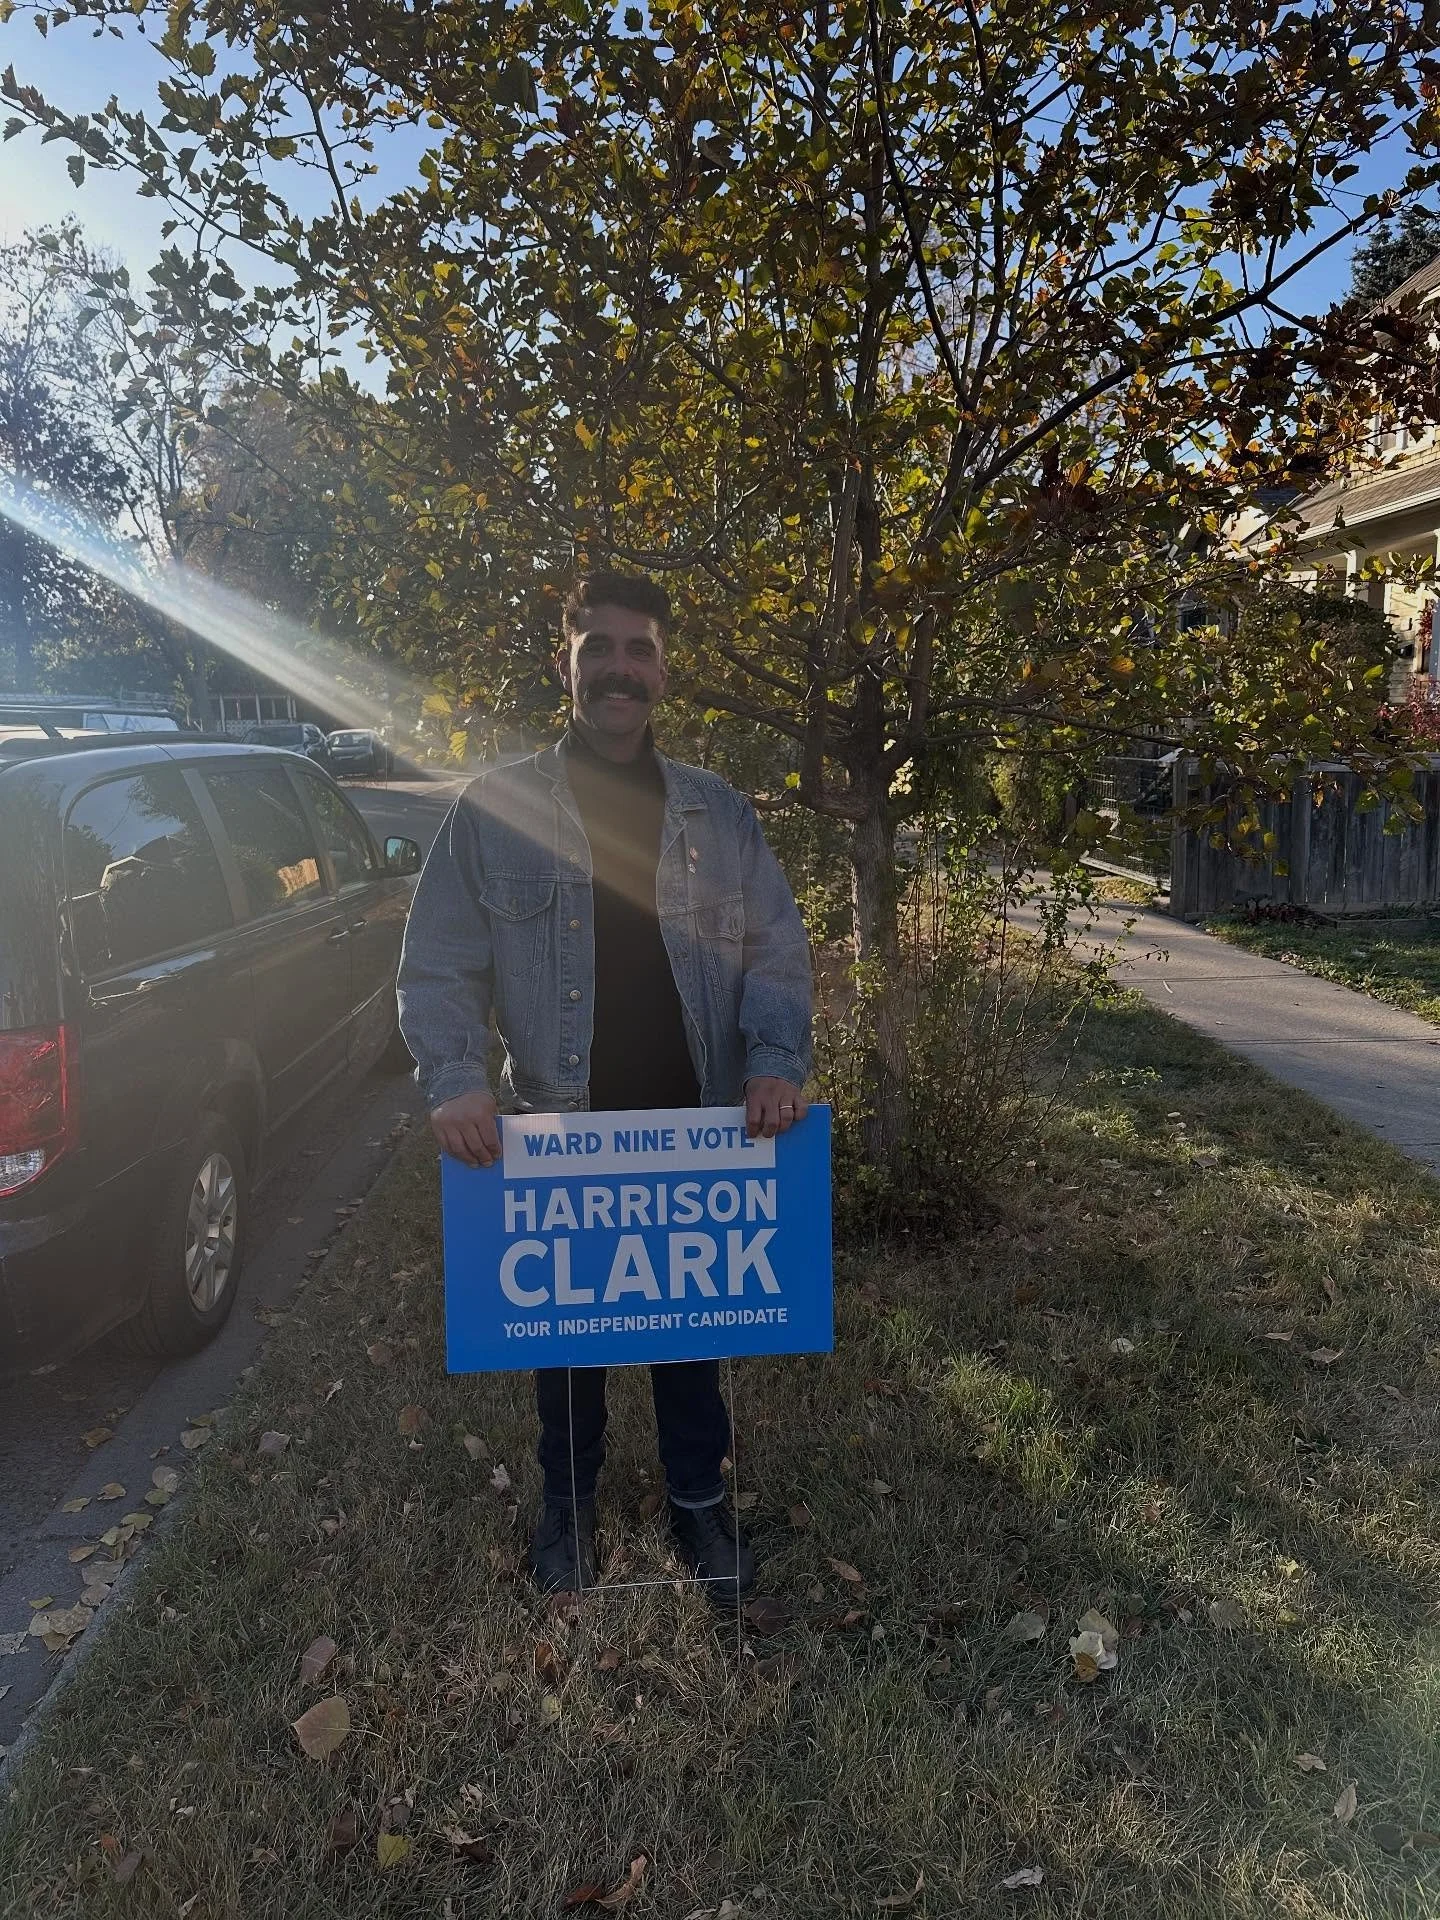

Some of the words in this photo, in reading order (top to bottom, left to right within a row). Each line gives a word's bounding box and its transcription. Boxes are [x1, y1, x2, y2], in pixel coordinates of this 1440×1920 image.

[524, 1132, 602, 1157] WARD
[614, 1128, 676, 1153] NINE
[504, 1179, 777, 1233] HARRISON
[499, 1228, 782, 1308] CLARK
[504, 1320, 551, 1338] YOUR
[558, 1313, 683, 1336] INDEPENDENT
[689, 1308, 788, 1328] CANDIDATE
